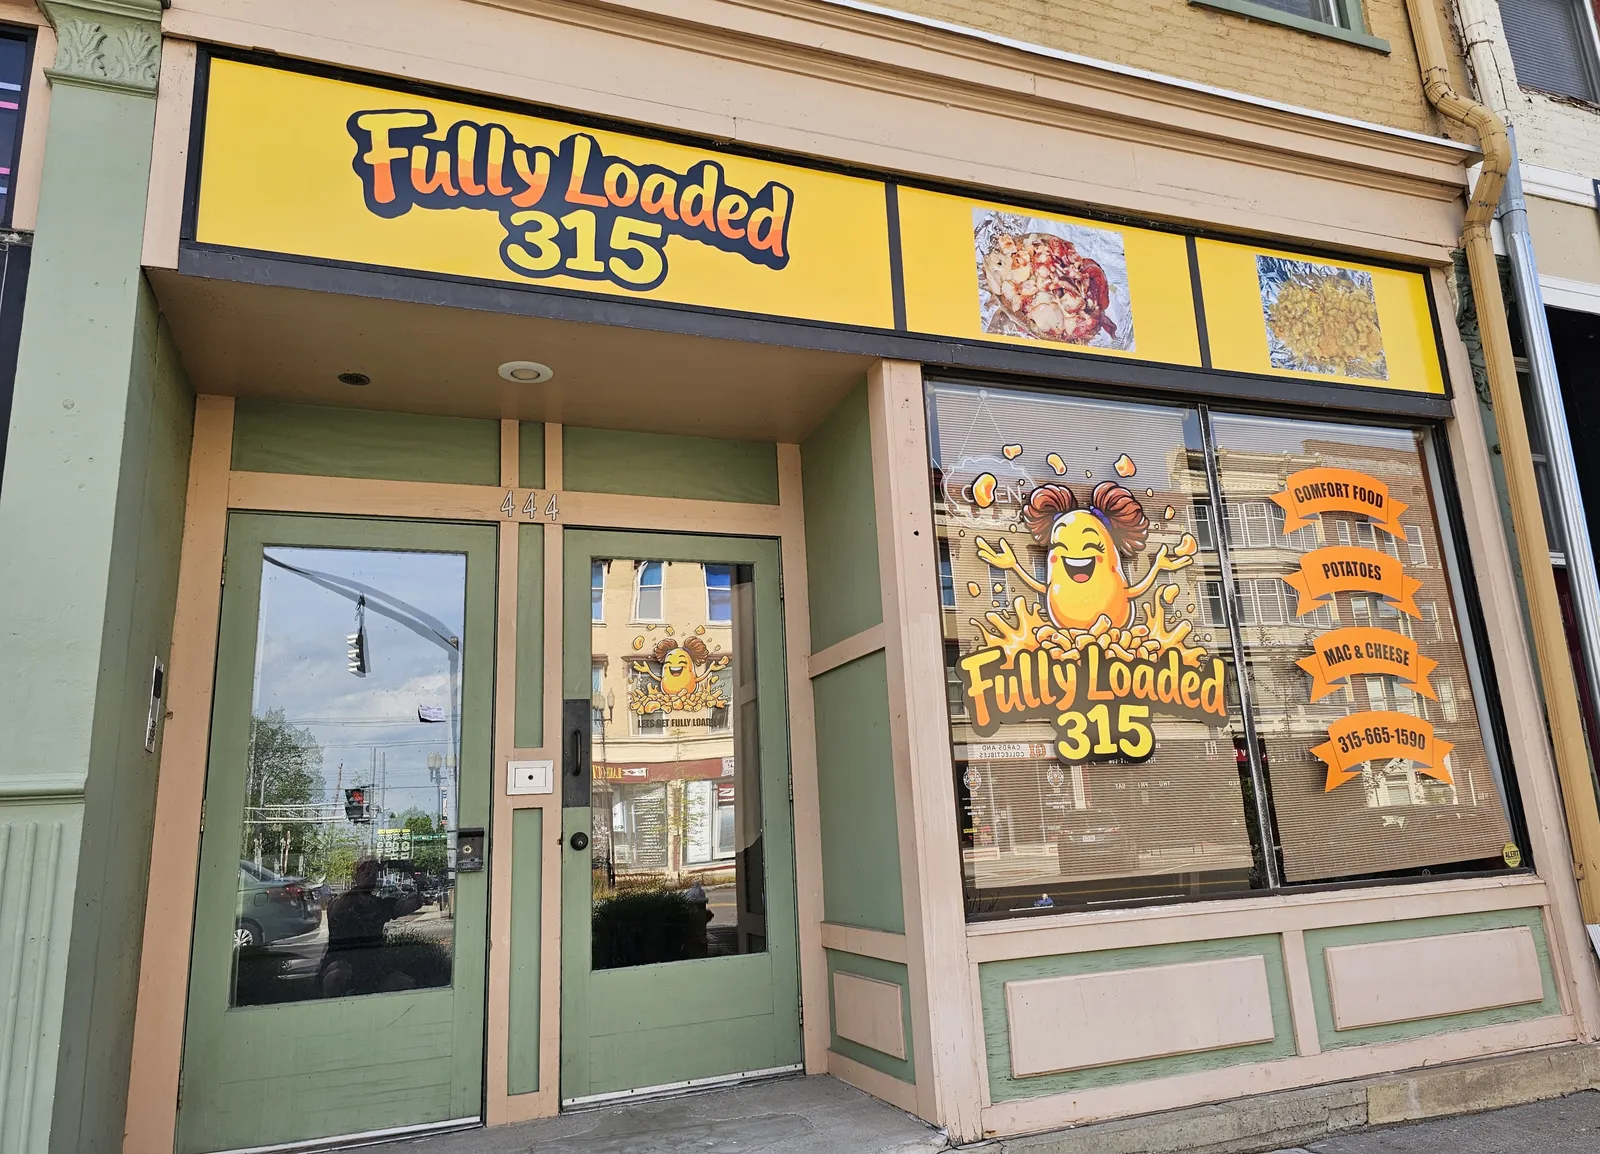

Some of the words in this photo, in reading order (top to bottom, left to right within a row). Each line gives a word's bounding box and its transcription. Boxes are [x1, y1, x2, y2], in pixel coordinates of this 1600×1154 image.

[356, 111, 552, 209] Fully
[564, 133, 790, 258] Loaded
[505, 208, 664, 286] 315
[500, 490, 560, 521] 444
[961, 484, 1023, 504] OEN
[1294, 482, 1350, 503] COMFORT
[1352, 485, 1384, 508] FOOD
[1321, 560, 1382, 581] POTATOES
[1323, 643, 1352, 667] MAC
[1354, 645, 1364, 659] &
[1365, 642, 1410, 667] CHEESE
[960, 649, 1078, 727] Fully
[1086, 644, 1227, 717] Loaded
[656, 719, 670, 728] GET
[671, 718, 692, 728] FULLY
[1056, 703, 1153, 760] 315
[1338, 726, 1426, 753] 315-665-1590
